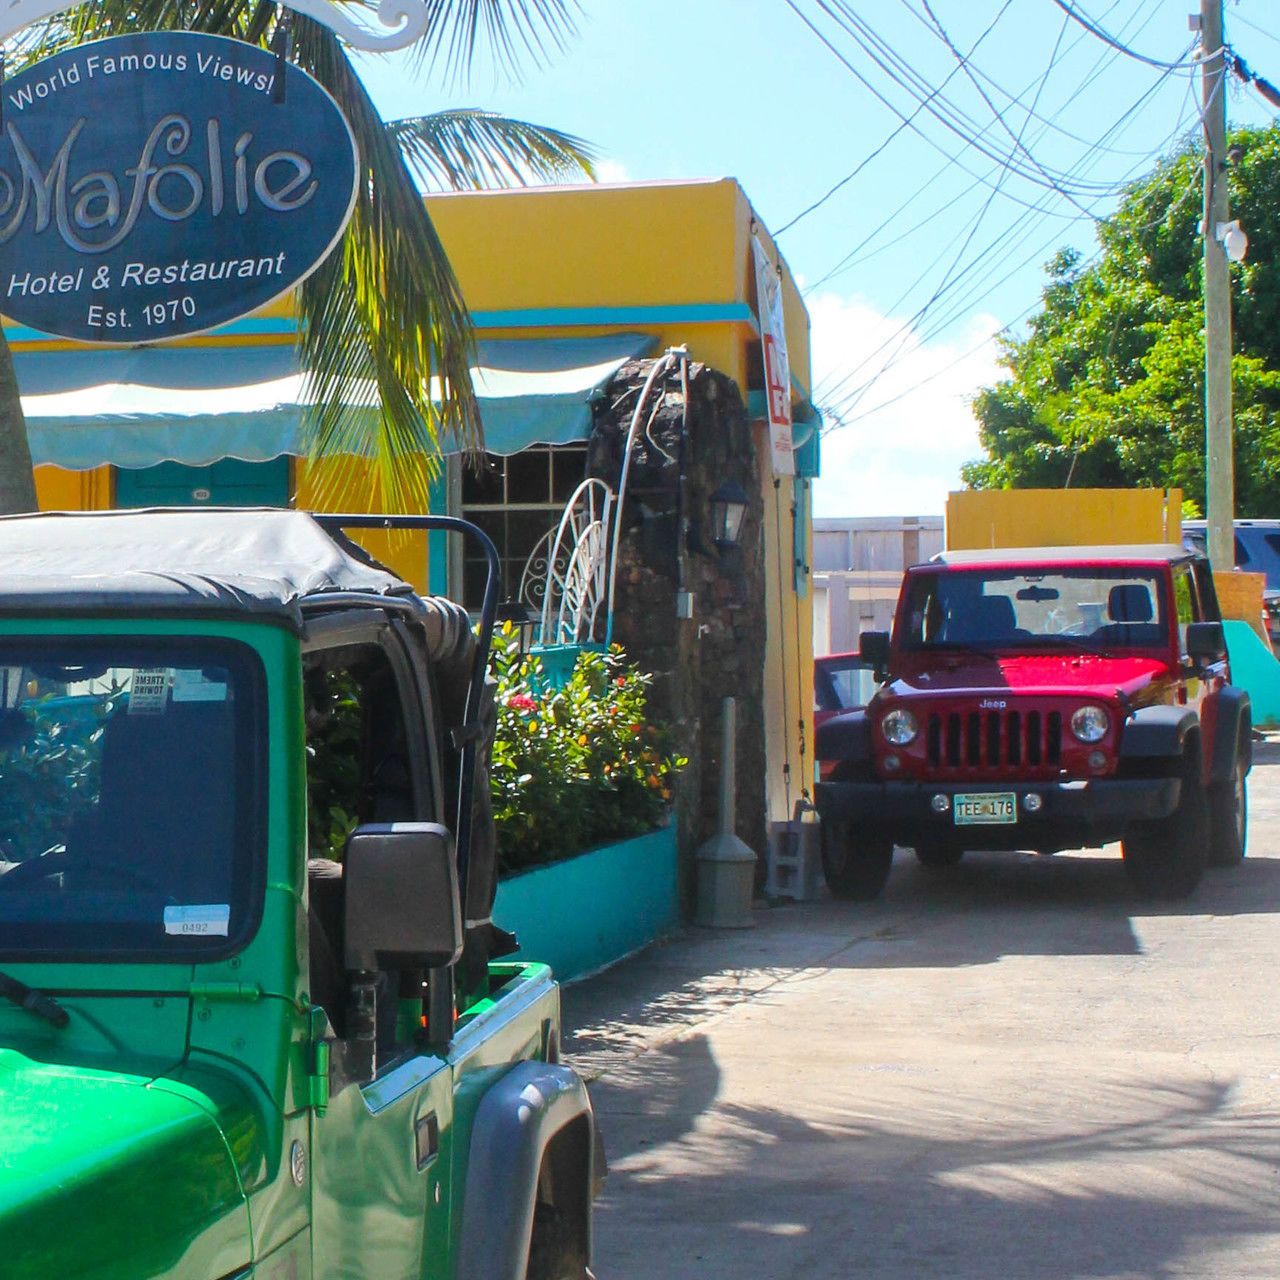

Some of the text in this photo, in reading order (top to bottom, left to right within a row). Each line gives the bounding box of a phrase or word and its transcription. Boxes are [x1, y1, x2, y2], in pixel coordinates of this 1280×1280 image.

[9, 52, 276, 111] World Famous Views!
[7, 252, 287, 298] Hotel & Restaurant
[88, 296, 197, 328] Est. 1970
[979, 699, 1007, 710] Jeep
[957, 801, 1014, 816] TEE 178
